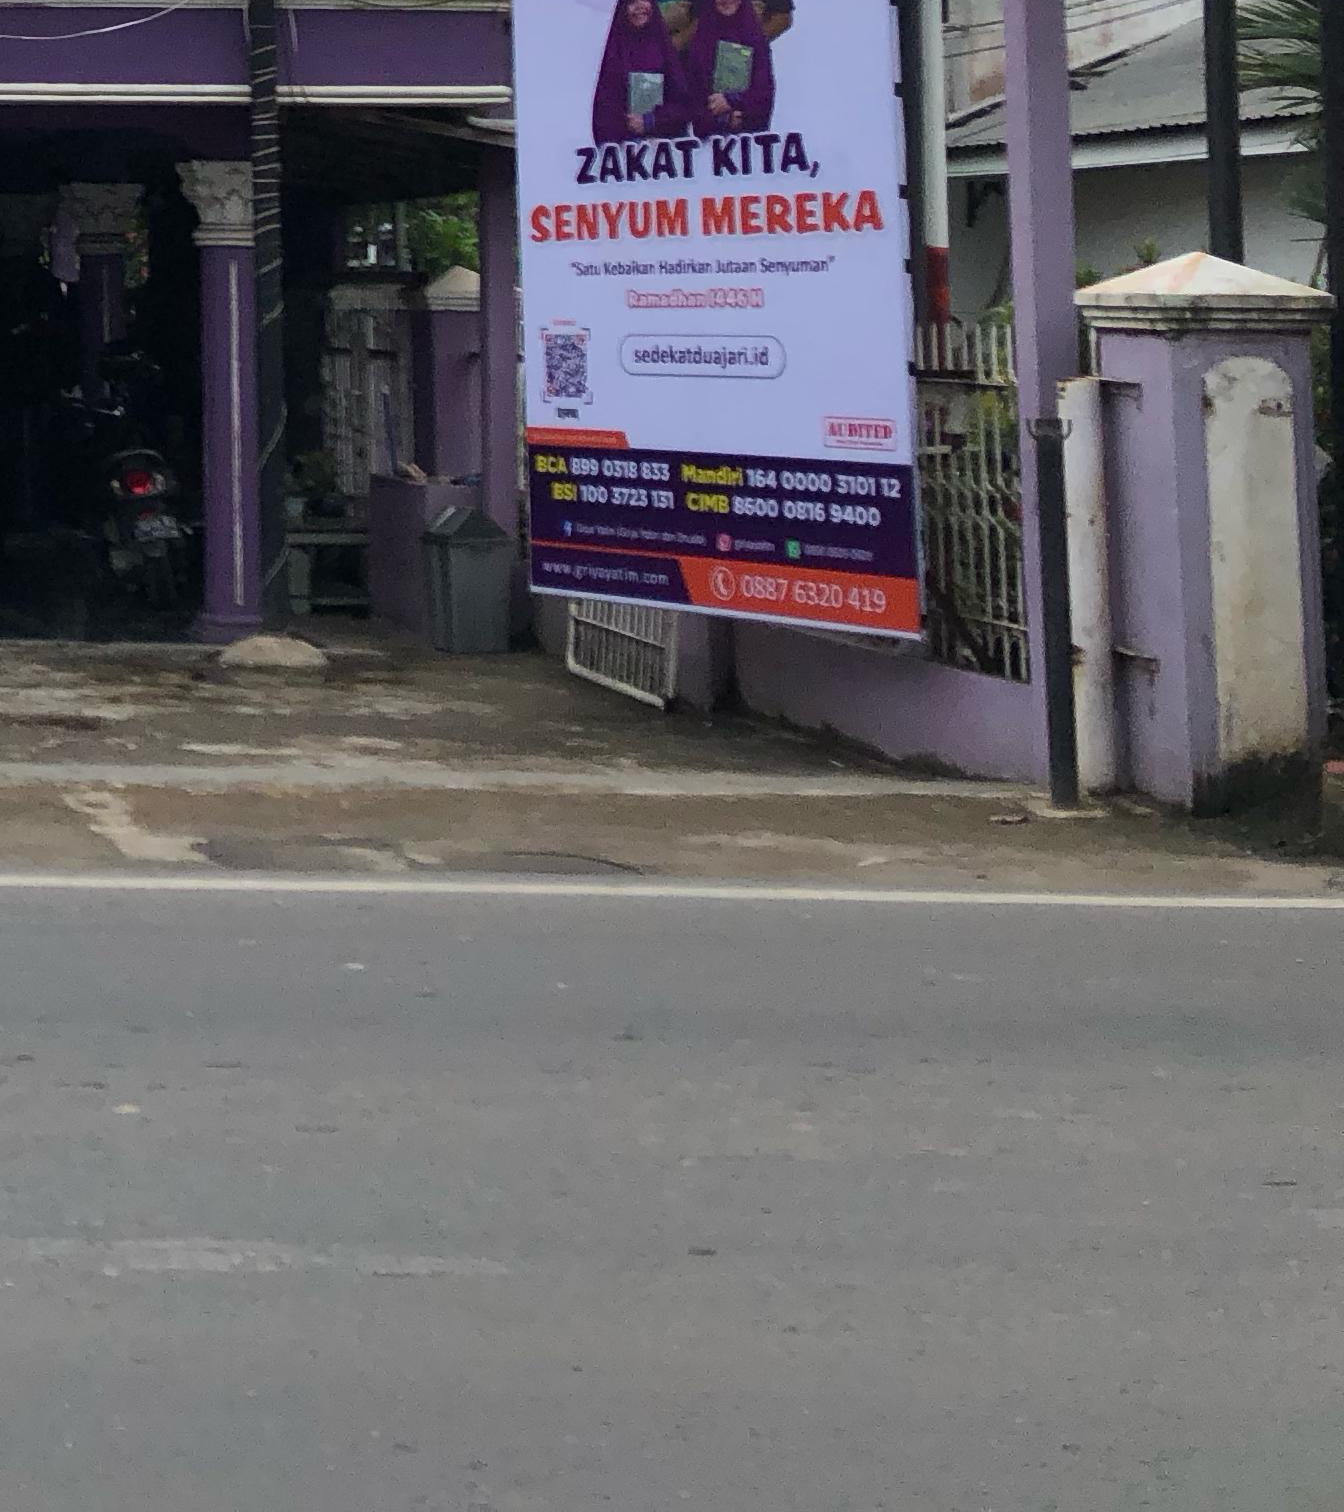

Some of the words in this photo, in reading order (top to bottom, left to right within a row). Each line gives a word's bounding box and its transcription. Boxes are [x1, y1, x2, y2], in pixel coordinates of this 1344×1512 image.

[574, 138, 701, 184] ZAKAT
[711, 131, 821, 179] KITA,
[528, 196, 689, 245] SENYUM
[701, 188, 884, 236] MEREKA
[603, 260, 656, 276] Kebaikan
[659, 259, 712, 275] Hadirkan
[715, 259, 757, 274] Jutaan
[626, 287, 707, 309] Ramadhan
[633, 345, 770, 369] sedekatduajari.id
[827, 422, 893, 439] AUDITED
[534, 453, 568, 474] BCA
[569, 456, 600, 476] 899
[679, 463, 744, 487] Mandiri
[779, 470, 833, 493] 0000
[879, 477, 902, 499] 12
[684, 490, 730, 515] CIMB
[828, 502, 882, 528] 9400
[541, 560, 670, 586] www.griyayatim.com
[740, 574, 789, 601] 0887
[791, 580, 844, 609] 6320
[847, 585, 887, 614] 419
